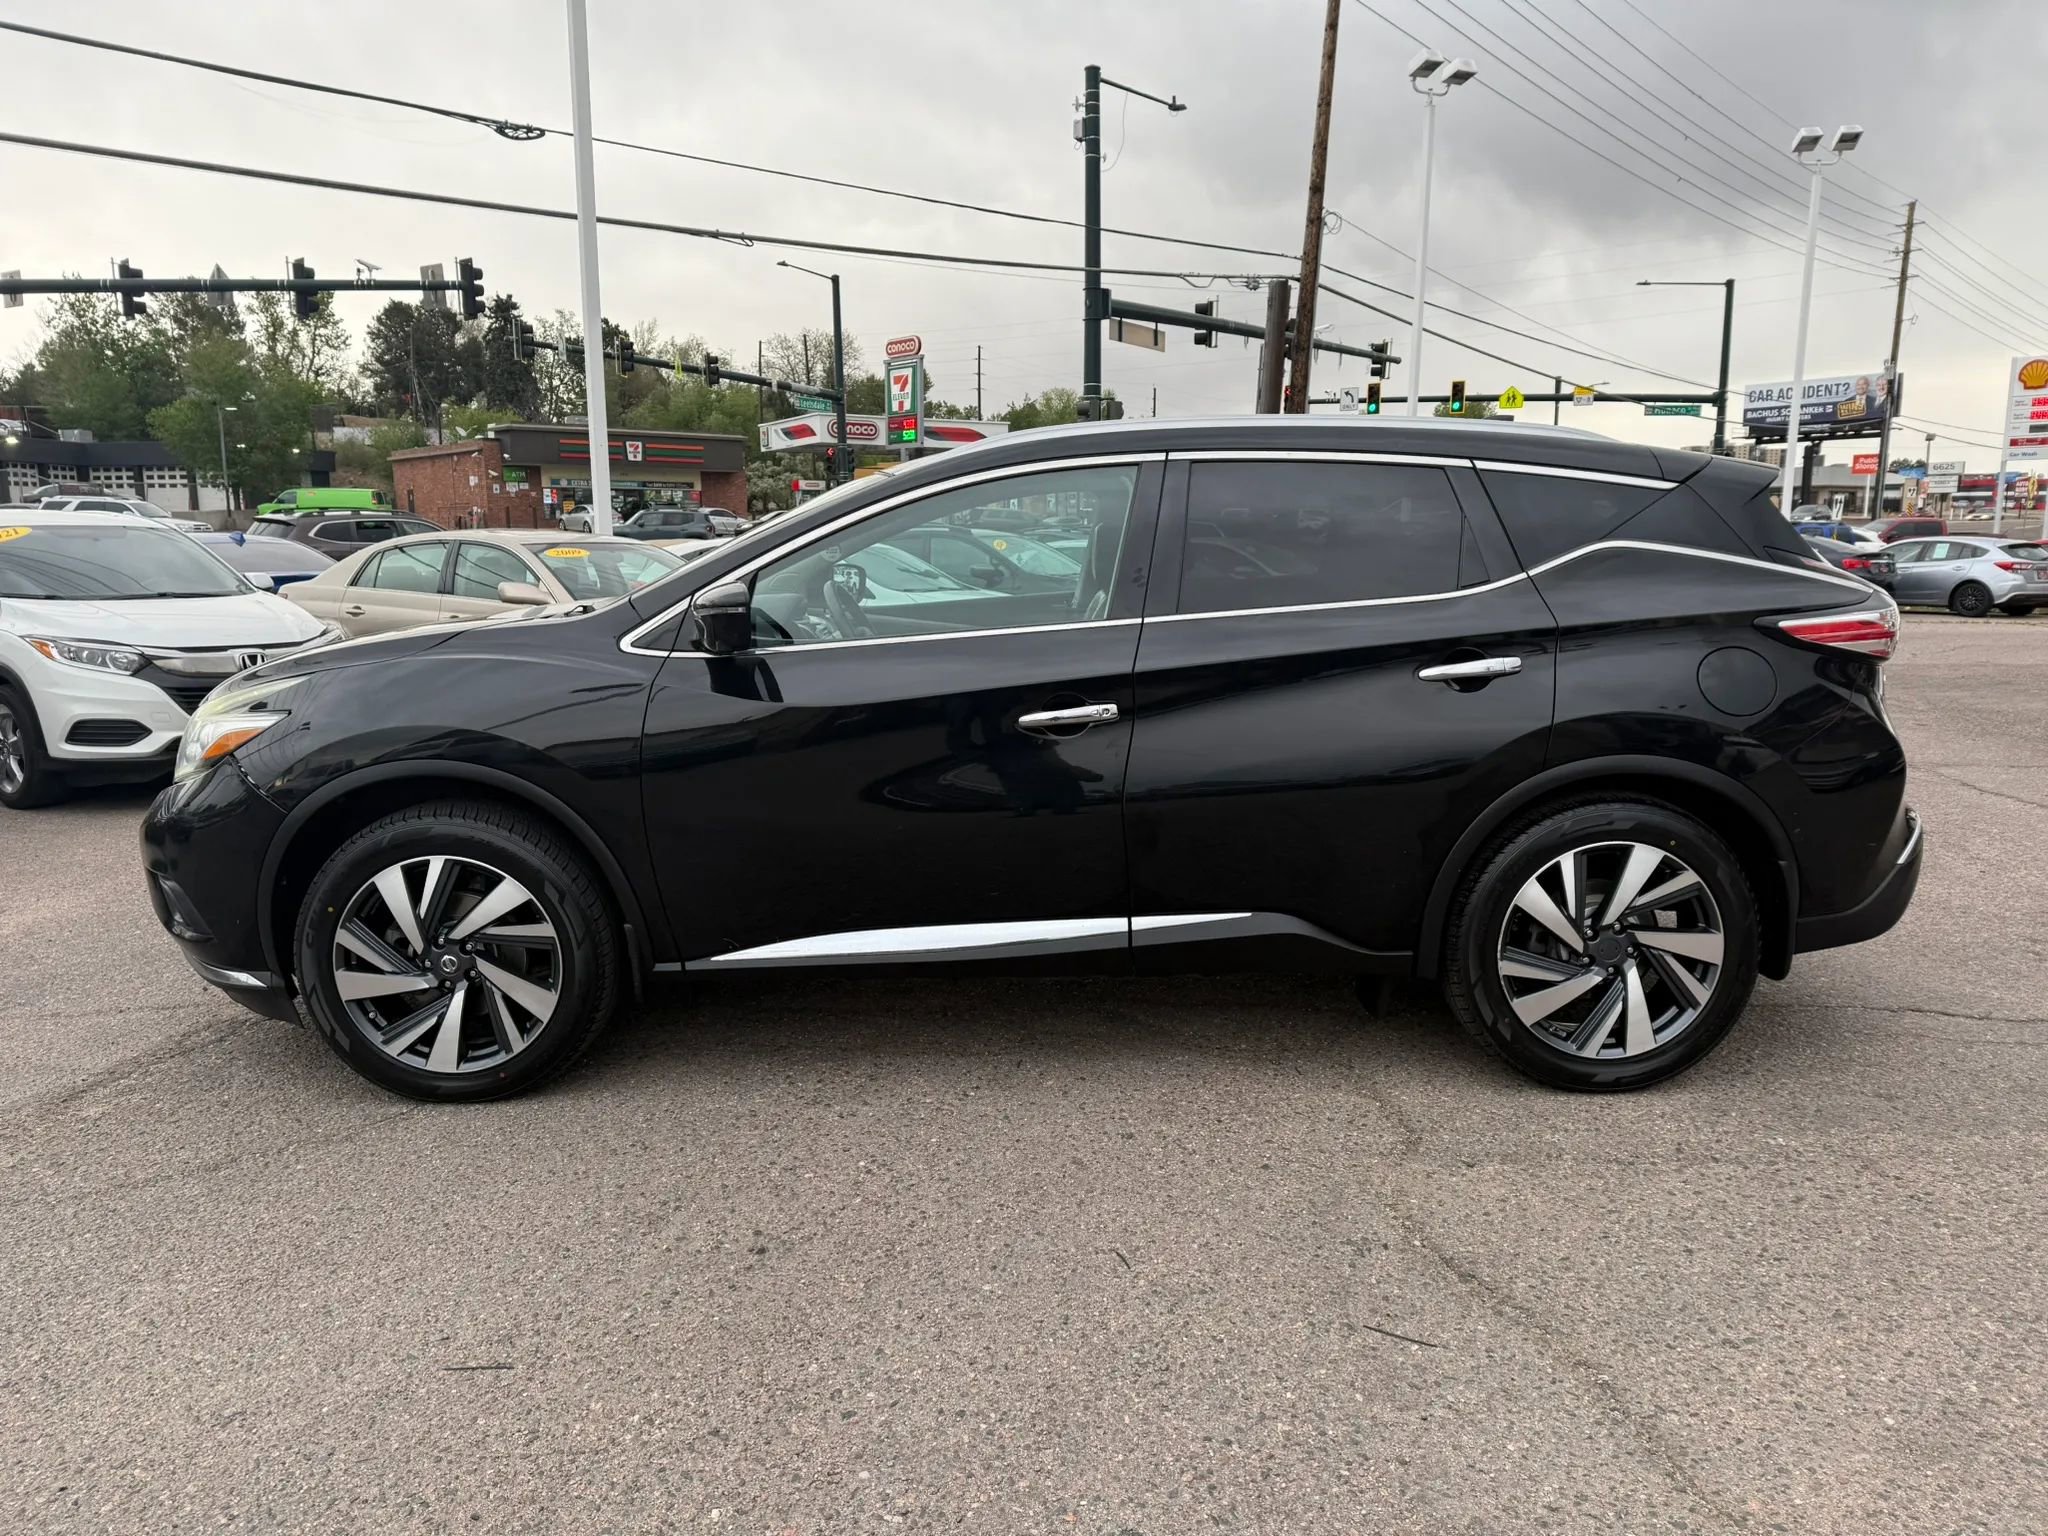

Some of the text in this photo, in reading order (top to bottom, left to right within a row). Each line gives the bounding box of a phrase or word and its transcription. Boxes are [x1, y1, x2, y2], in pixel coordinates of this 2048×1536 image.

[1749, 382, 1850, 403] CAR ACIDENT?
[1746, 408, 1778, 418] BACHUS
[1932, 463, 1956, 471] 6625
